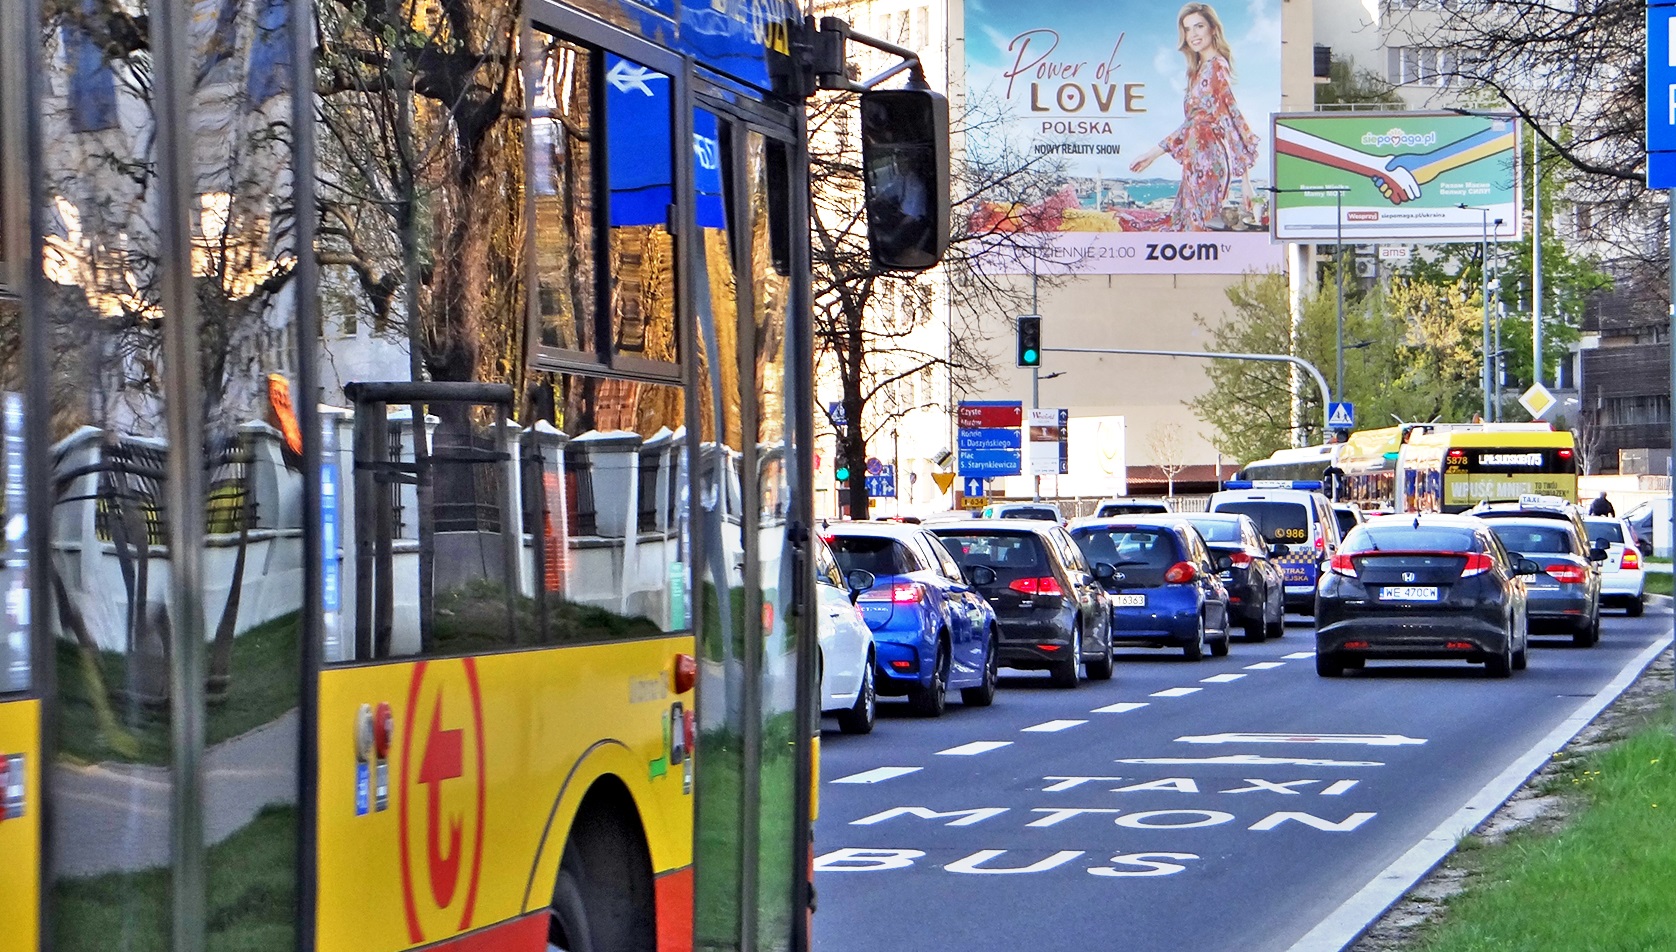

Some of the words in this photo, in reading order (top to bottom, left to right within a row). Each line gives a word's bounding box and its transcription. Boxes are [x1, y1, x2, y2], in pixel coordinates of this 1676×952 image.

[1003, 27, 1087, 100] Power
[1096, 31, 1125, 85] of
[1030, 82, 1147, 113] LOVE
[1041, 121, 1113, 134] POLSKA
[1034, 144, 1060, 155] NOWY
[1062, 144, 1095, 155] REALITY
[1096, 144, 1120, 155] SHOW
[1099, 246, 1135, 259] 21:00
[1221, 244, 1232, 253] tv
[1382, 248, 1406, 257] ams
[960, 408, 981, 417] Czyste
[967, 439, 1011, 448] Daszyńskiego
[968, 461, 1017, 470] Starynkiewicza
[1446, 456, 1468, 465] 5878
[1451, 480, 1493, 498] WPUŚĆ
[1286, 528, 1305, 538] 986
[1284, 574, 1309, 582] EJSKA
[1386, 588, 1400, 598] WE
[1404, 588, 1436, 598] 470CW
[1042, 776, 1360, 796] TAXI
[849, 806, 1377, 833] MTON
[813, 848, 1200, 878] BUS
